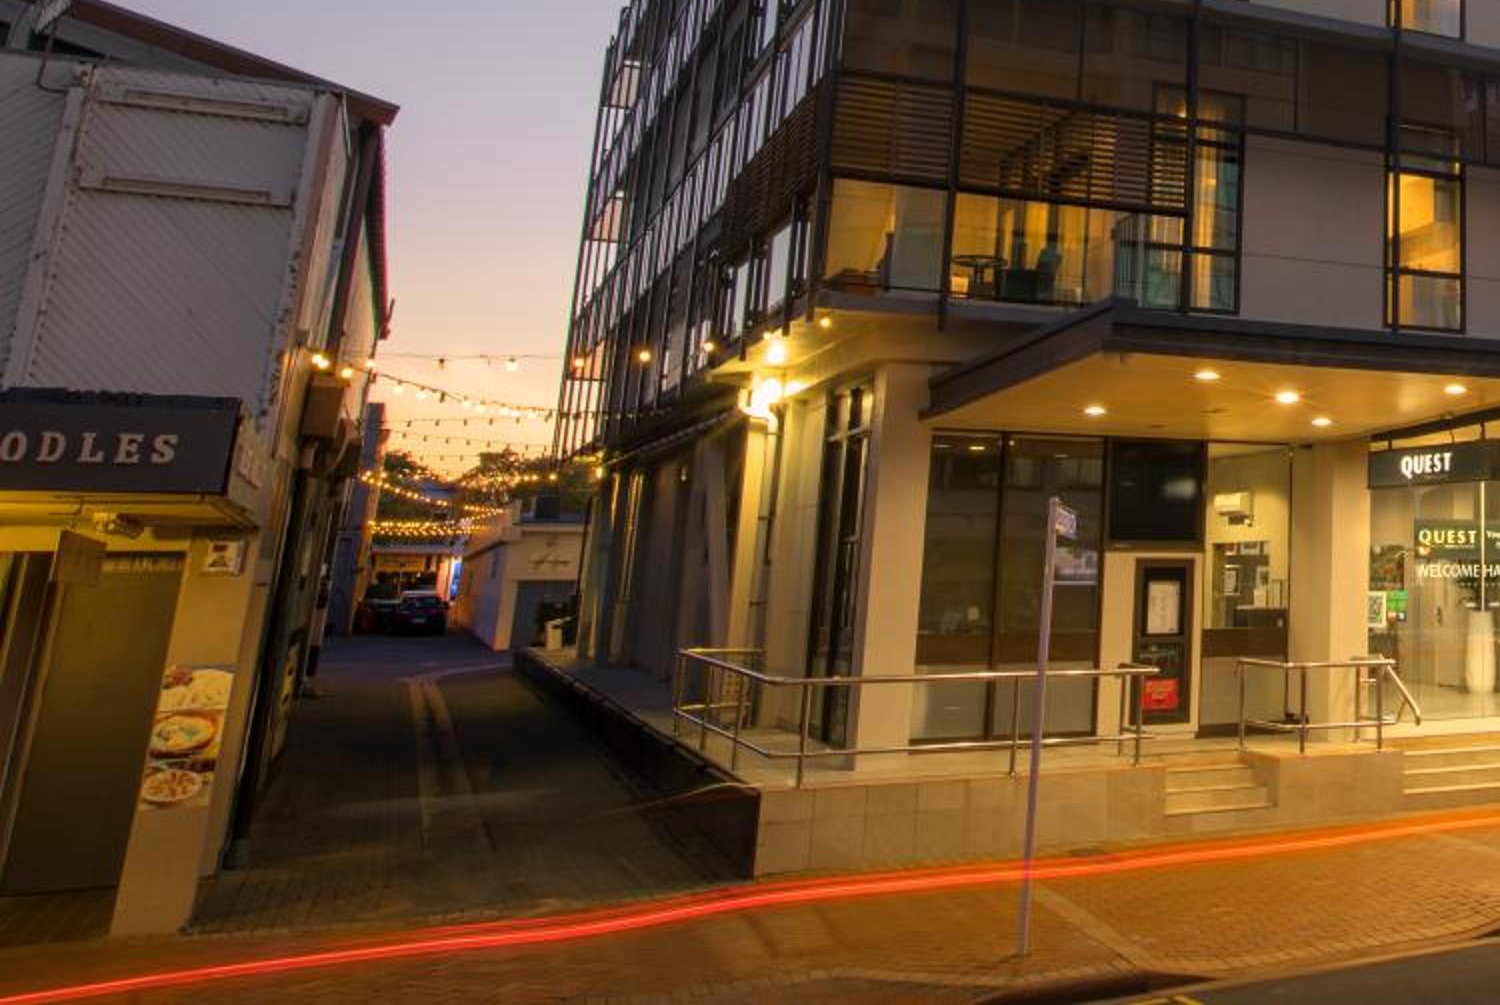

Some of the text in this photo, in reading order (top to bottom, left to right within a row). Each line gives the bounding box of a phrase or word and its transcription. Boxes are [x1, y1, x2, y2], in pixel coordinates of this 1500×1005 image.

[1401, 452, 1452, 479] QUEST
[1418, 529, 1477, 546] QUEST
[1416, 563, 1481, 578] WELCOME
